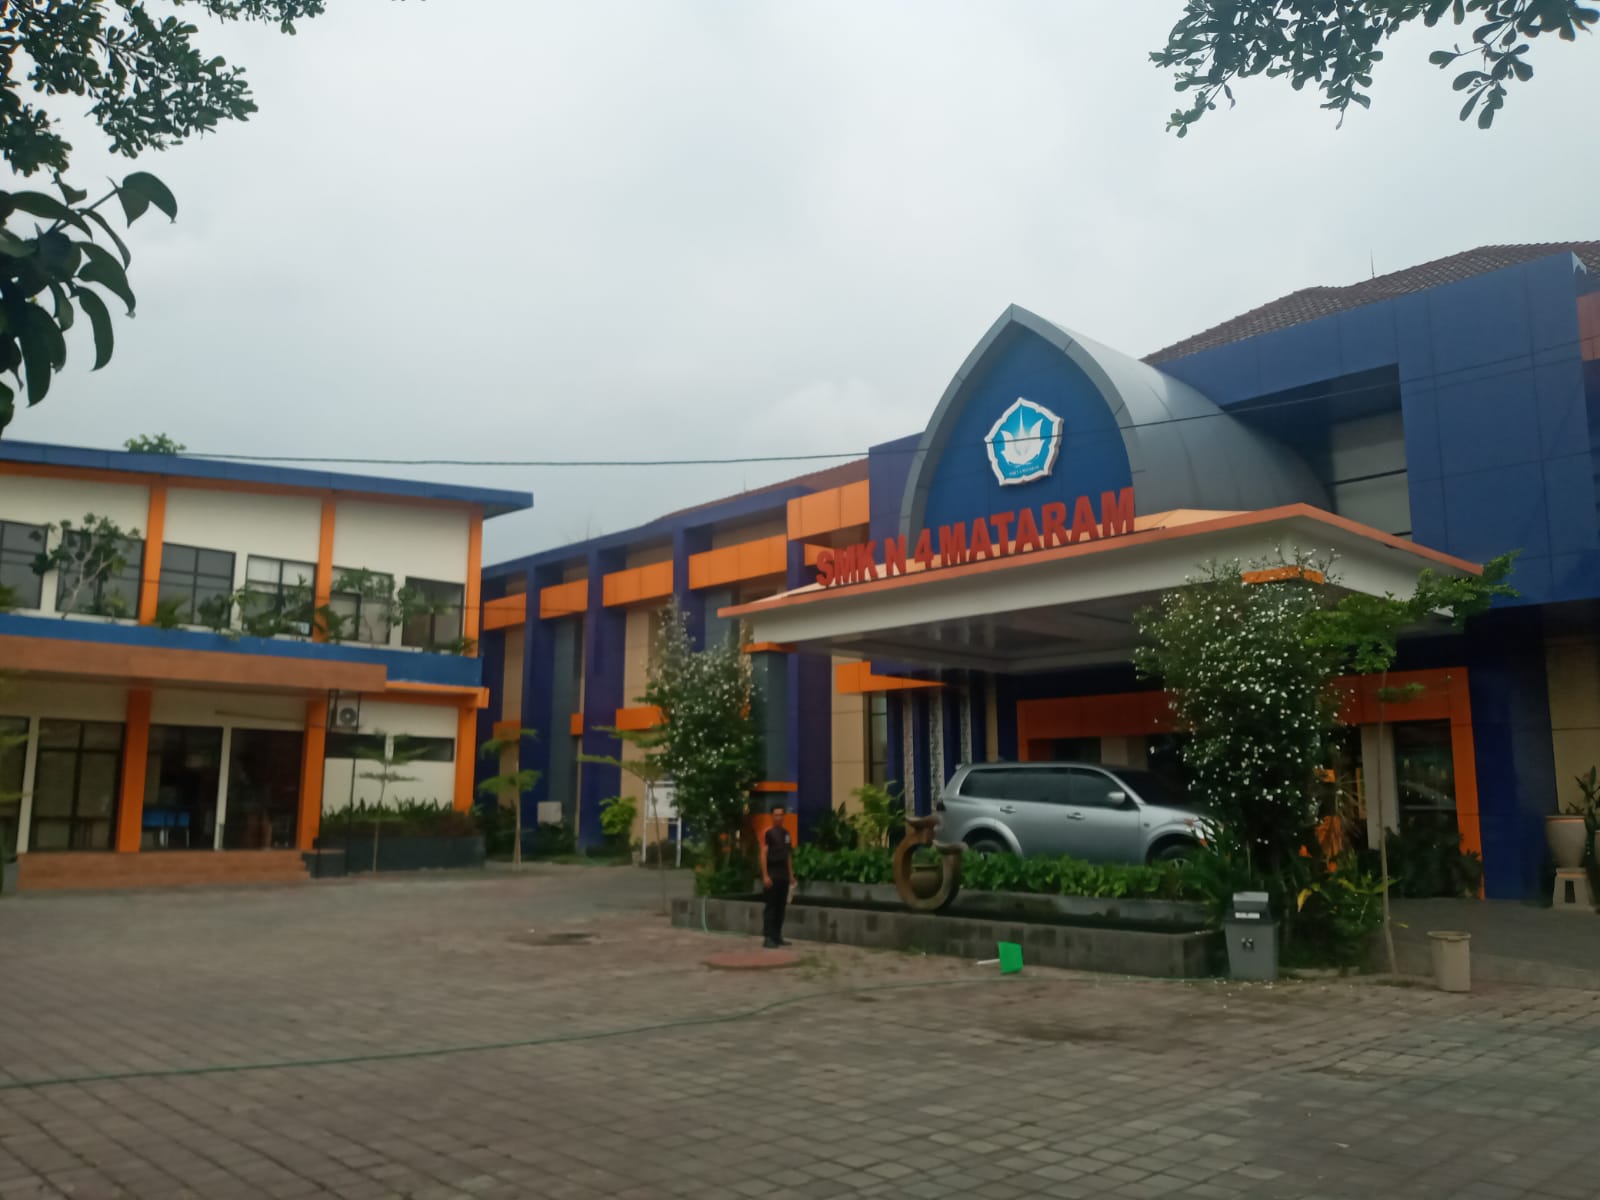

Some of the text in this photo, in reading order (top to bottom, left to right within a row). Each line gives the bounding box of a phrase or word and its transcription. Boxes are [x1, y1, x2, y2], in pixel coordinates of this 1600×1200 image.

[816, 487, 1135, 586] SMK N 4 MATARAM
